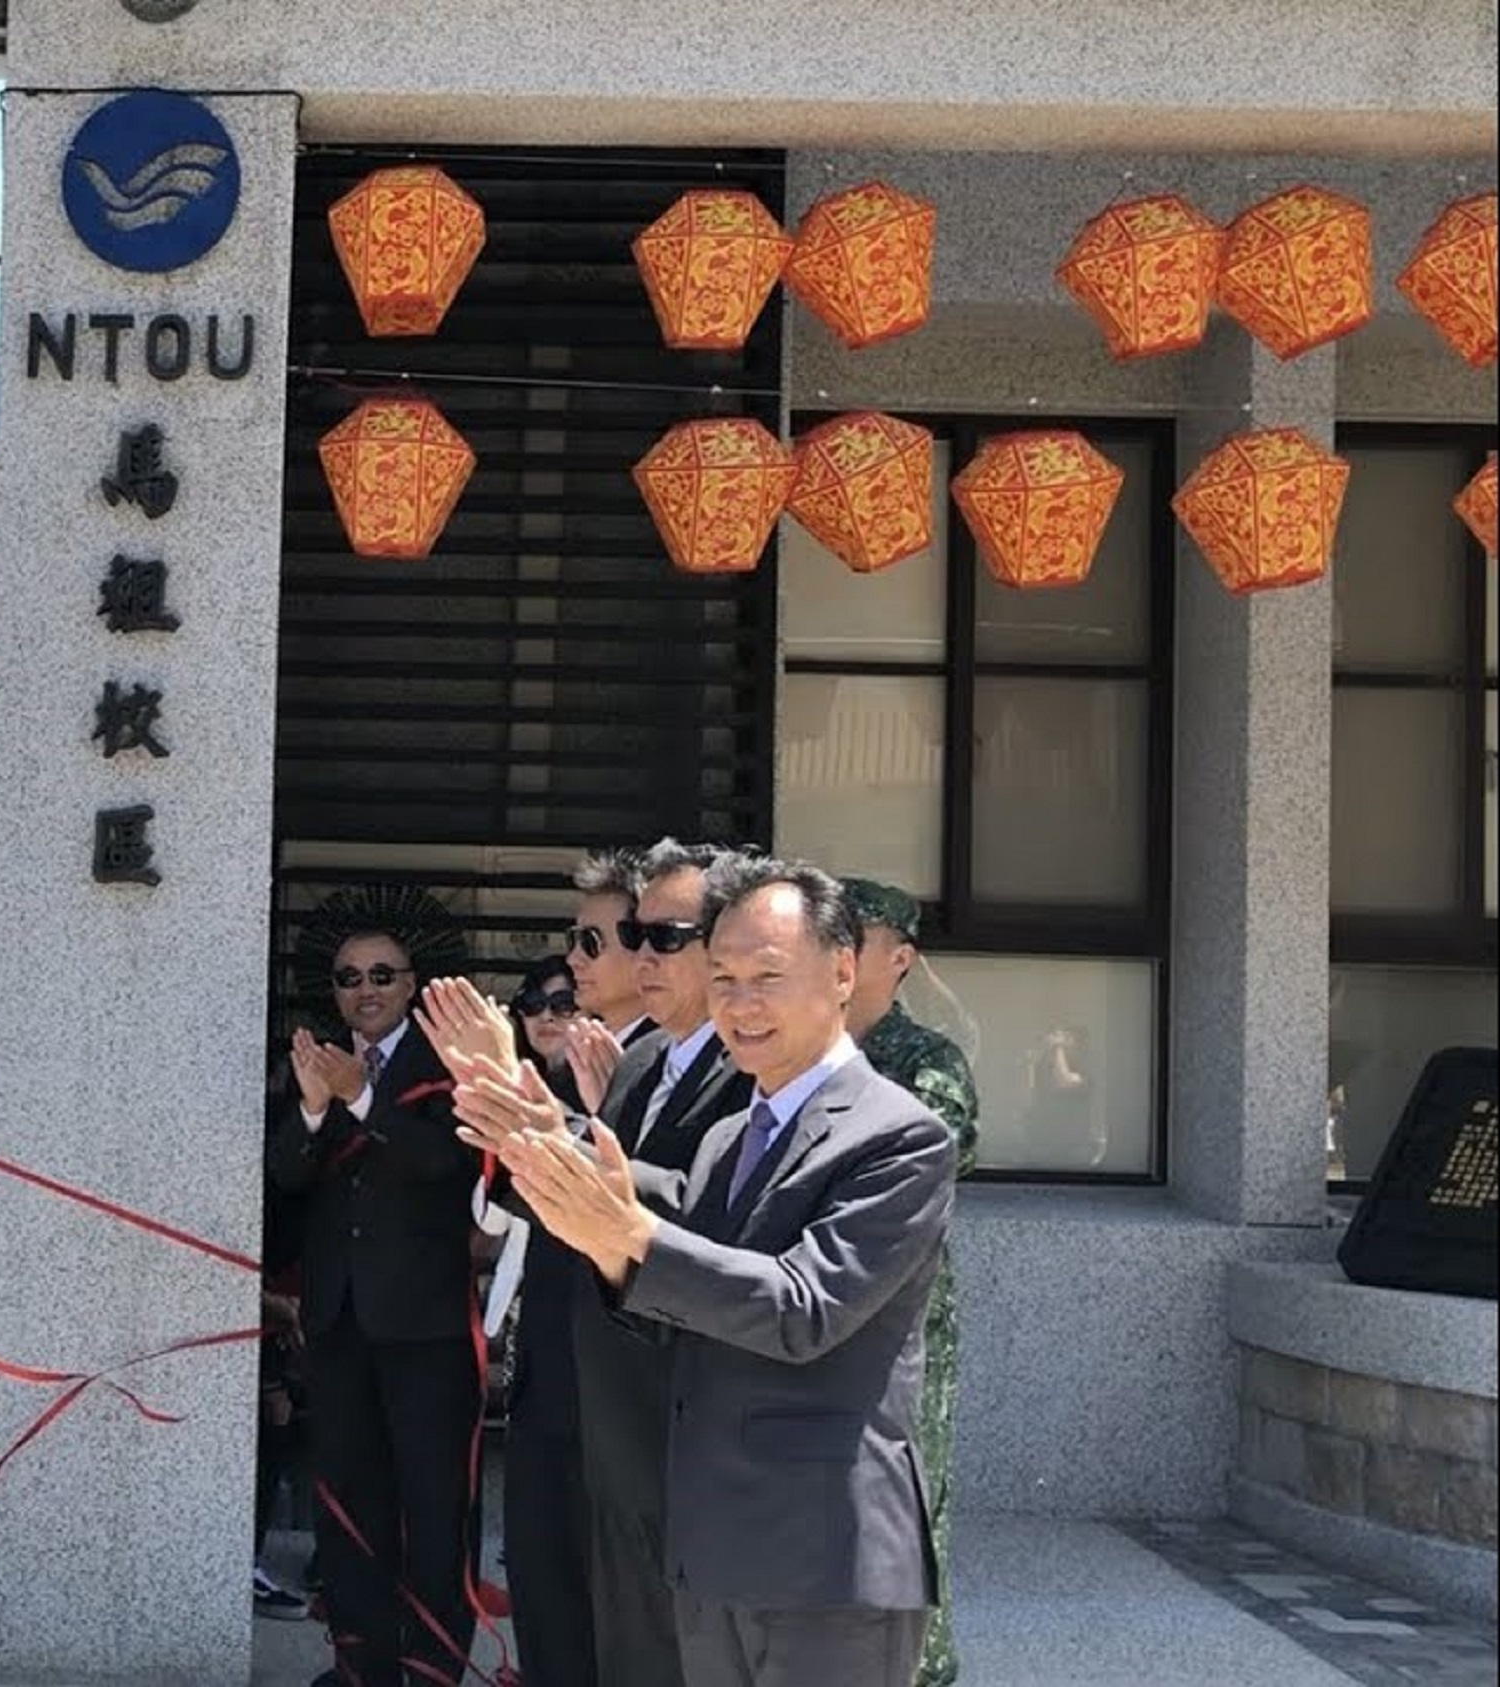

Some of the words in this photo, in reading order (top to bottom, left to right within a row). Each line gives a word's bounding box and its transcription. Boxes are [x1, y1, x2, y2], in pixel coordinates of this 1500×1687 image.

[26, 312, 255, 382] NTOU
[90, 422, 182, 888] 馬祖校區
